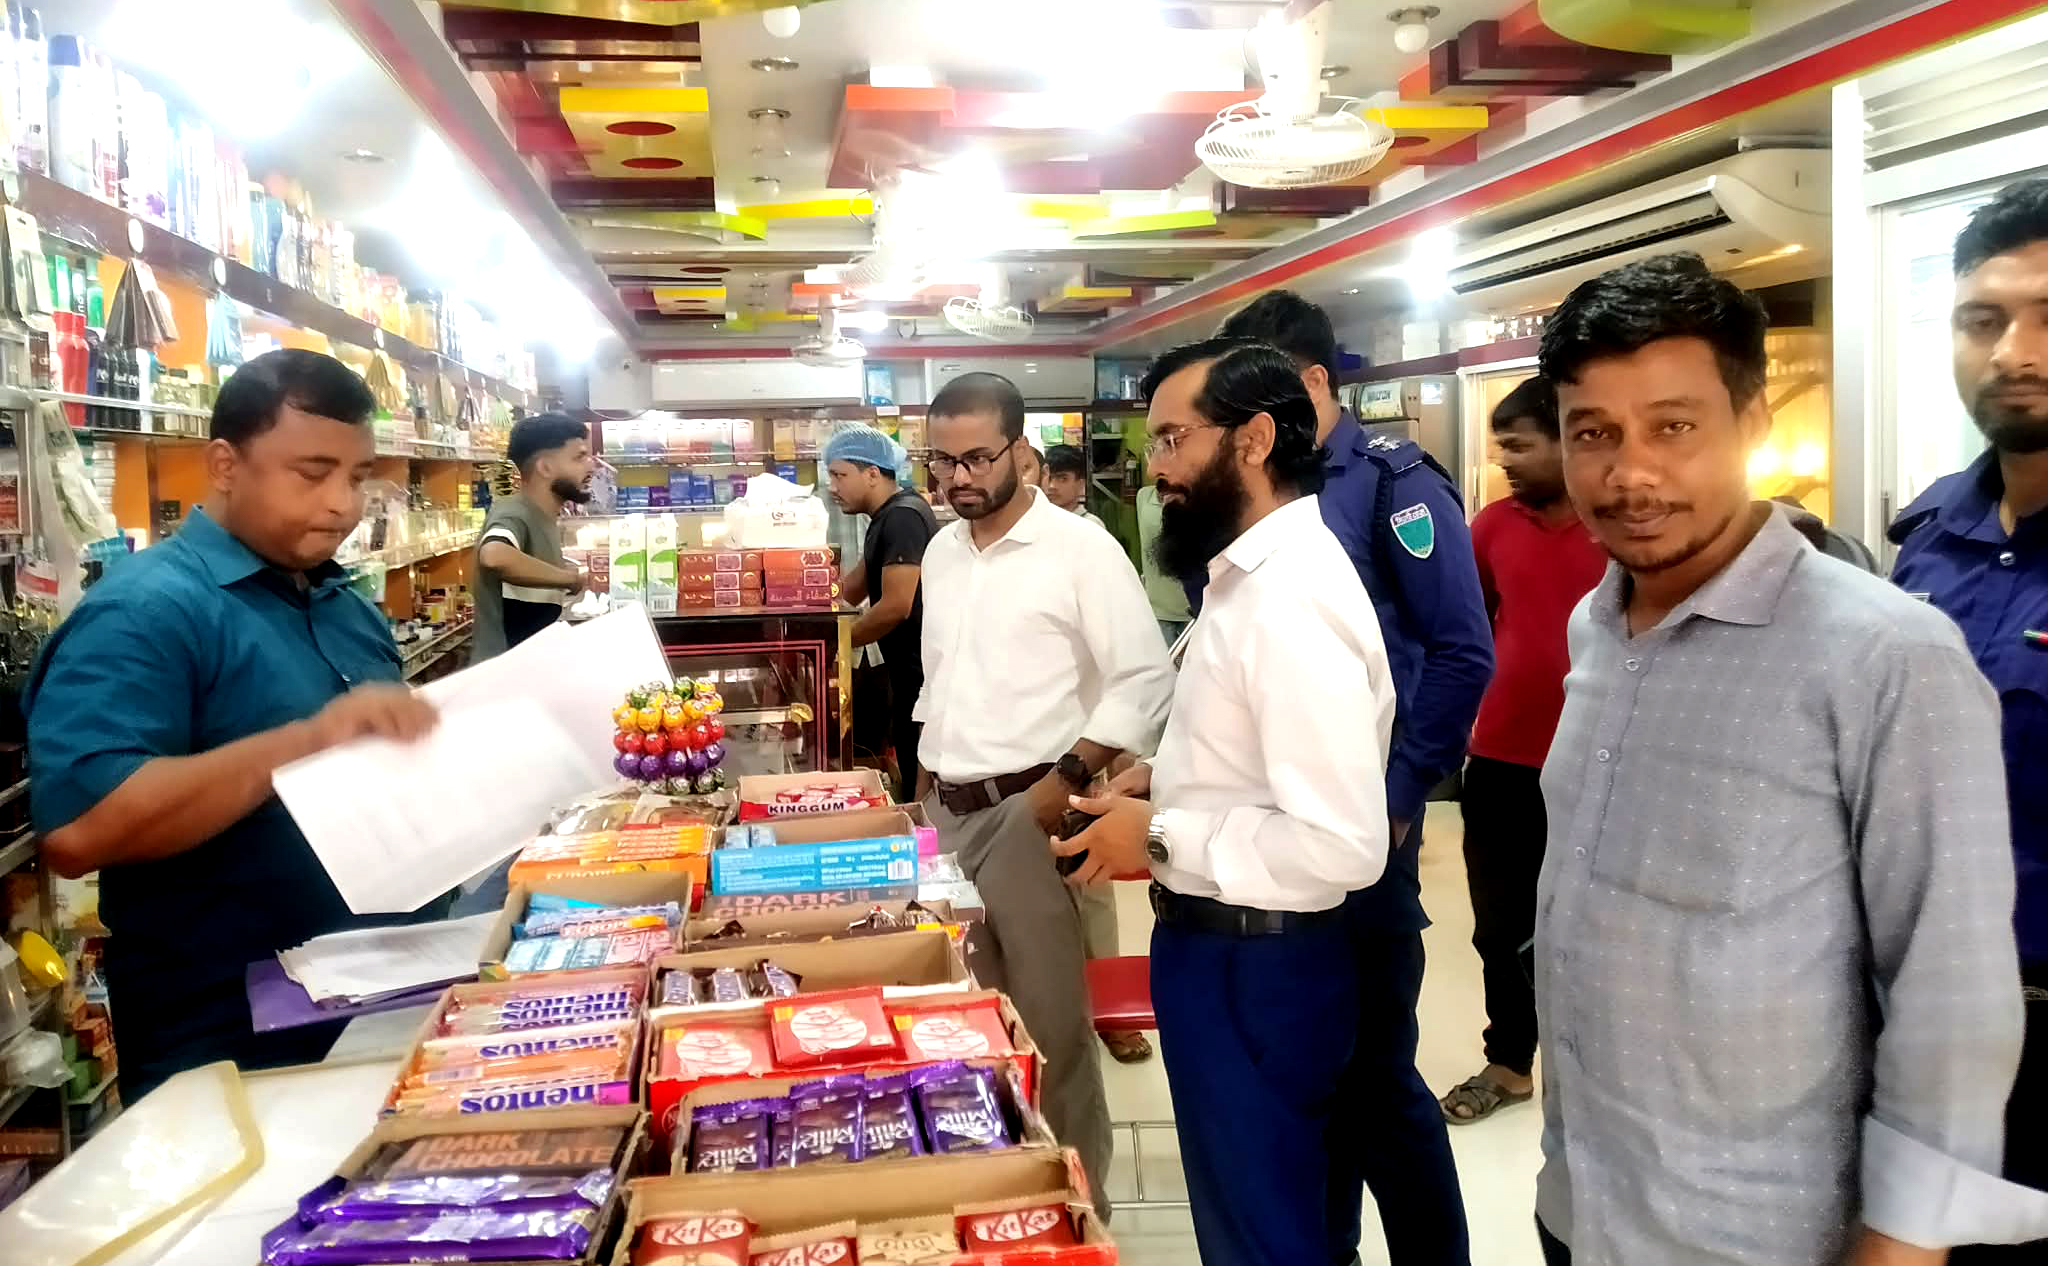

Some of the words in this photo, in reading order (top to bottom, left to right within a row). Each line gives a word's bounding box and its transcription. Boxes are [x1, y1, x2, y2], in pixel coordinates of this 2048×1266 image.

[768, 801, 846, 815] KINGGUM
[417, 1146, 614, 1171] CHOCOLATE
[662, 1218, 738, 1244] KitKat
[985, 1210, 1054, 1240] KitKat
